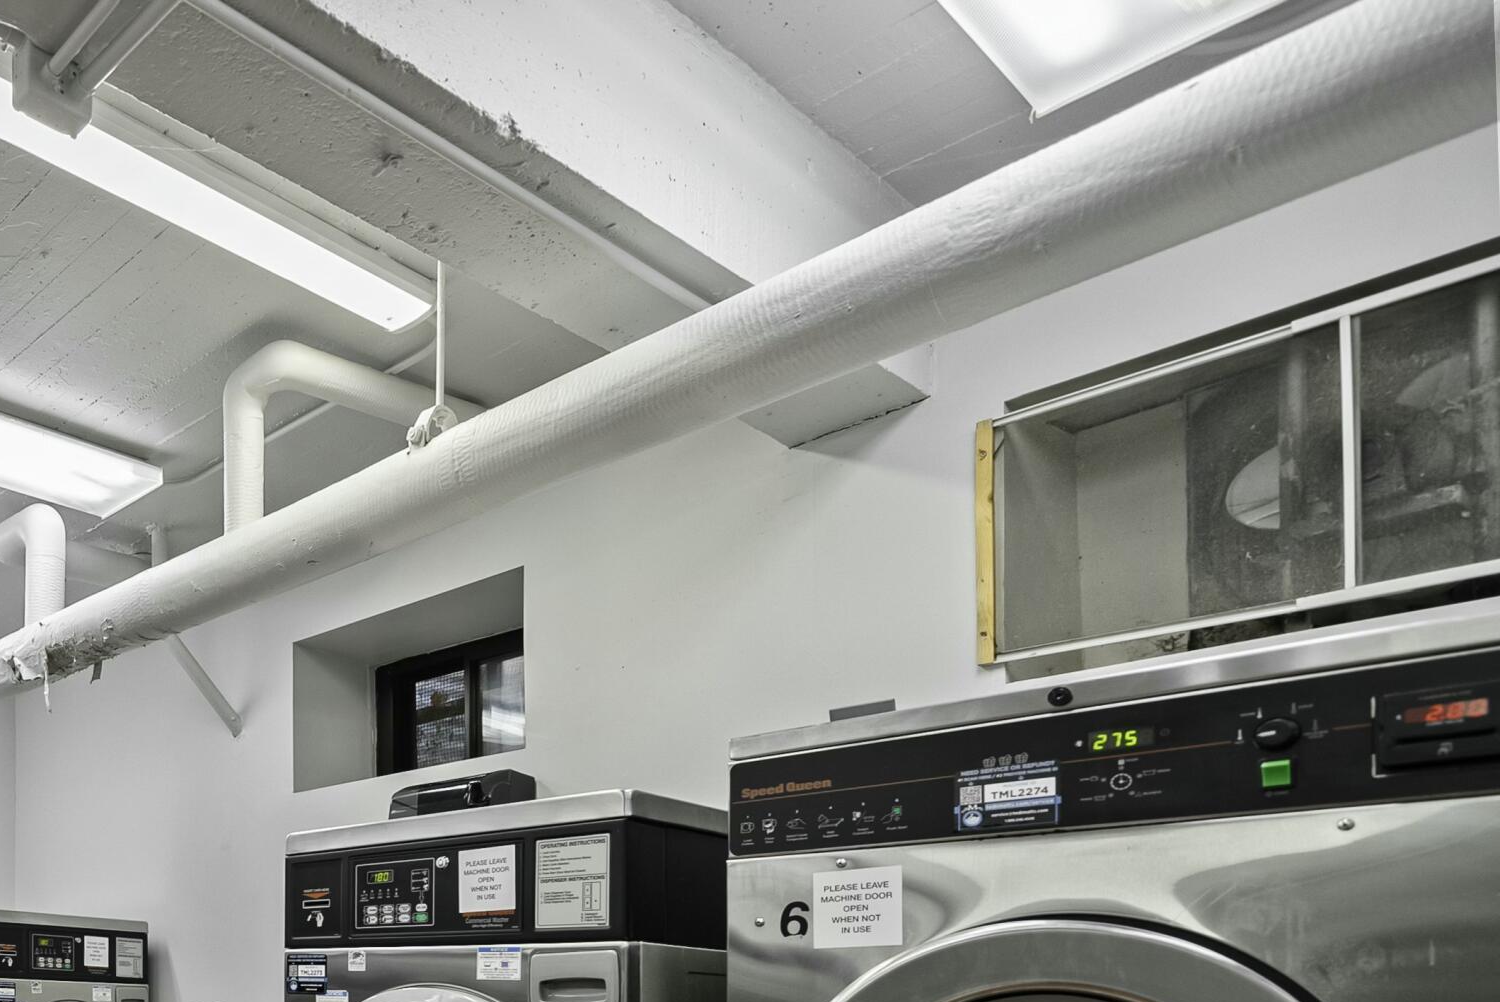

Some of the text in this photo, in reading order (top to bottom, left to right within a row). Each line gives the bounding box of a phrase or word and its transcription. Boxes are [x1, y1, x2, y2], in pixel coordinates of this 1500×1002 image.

[1092, 730, 1138, 751] 275
[741, 779, 832, 799] Speed Queen
[991, 786, 1048, 800] TML2274
[465, 857, 507, 867] PLEASE LEAVE
[375, 872, 389, 882] 180
[463, 868, 490, 876] MACHINE
[823, 880, 890, 893] PLEASE LEAVE
[820, 891, 893, 903] MACHINE DOOR
[843, 903, 869, 913] OPEN
[780, 901, 810, 938] 6
[831, 913, 881, 924] WHEN NOT
[841, 924, 872, 935] IN USE
